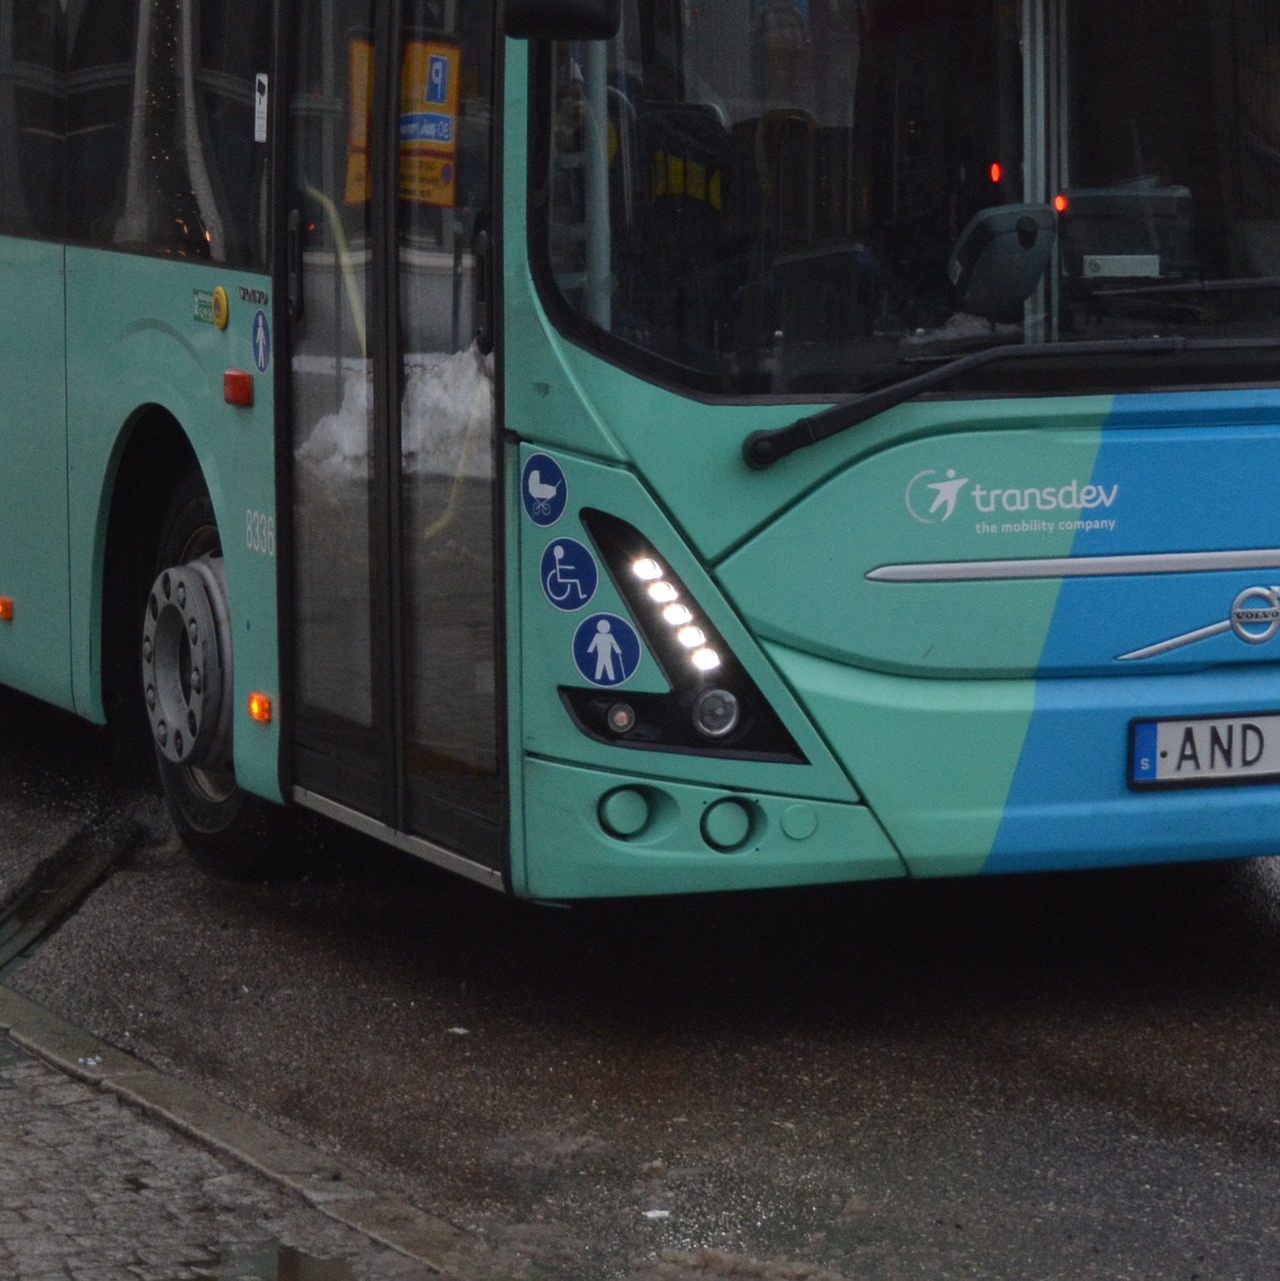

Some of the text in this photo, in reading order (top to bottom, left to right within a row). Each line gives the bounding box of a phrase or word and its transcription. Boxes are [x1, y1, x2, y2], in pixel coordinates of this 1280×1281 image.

[971, 479, 1119, 512] transdev
[246, 509, 275, 556] 8336
[976, 519, 1116, 534] the mobility company
[1234, 610, 1280, 620] VOLVO
[1176, 723, 1265, 771] AND
[1140, 758, 1150, 770] S
